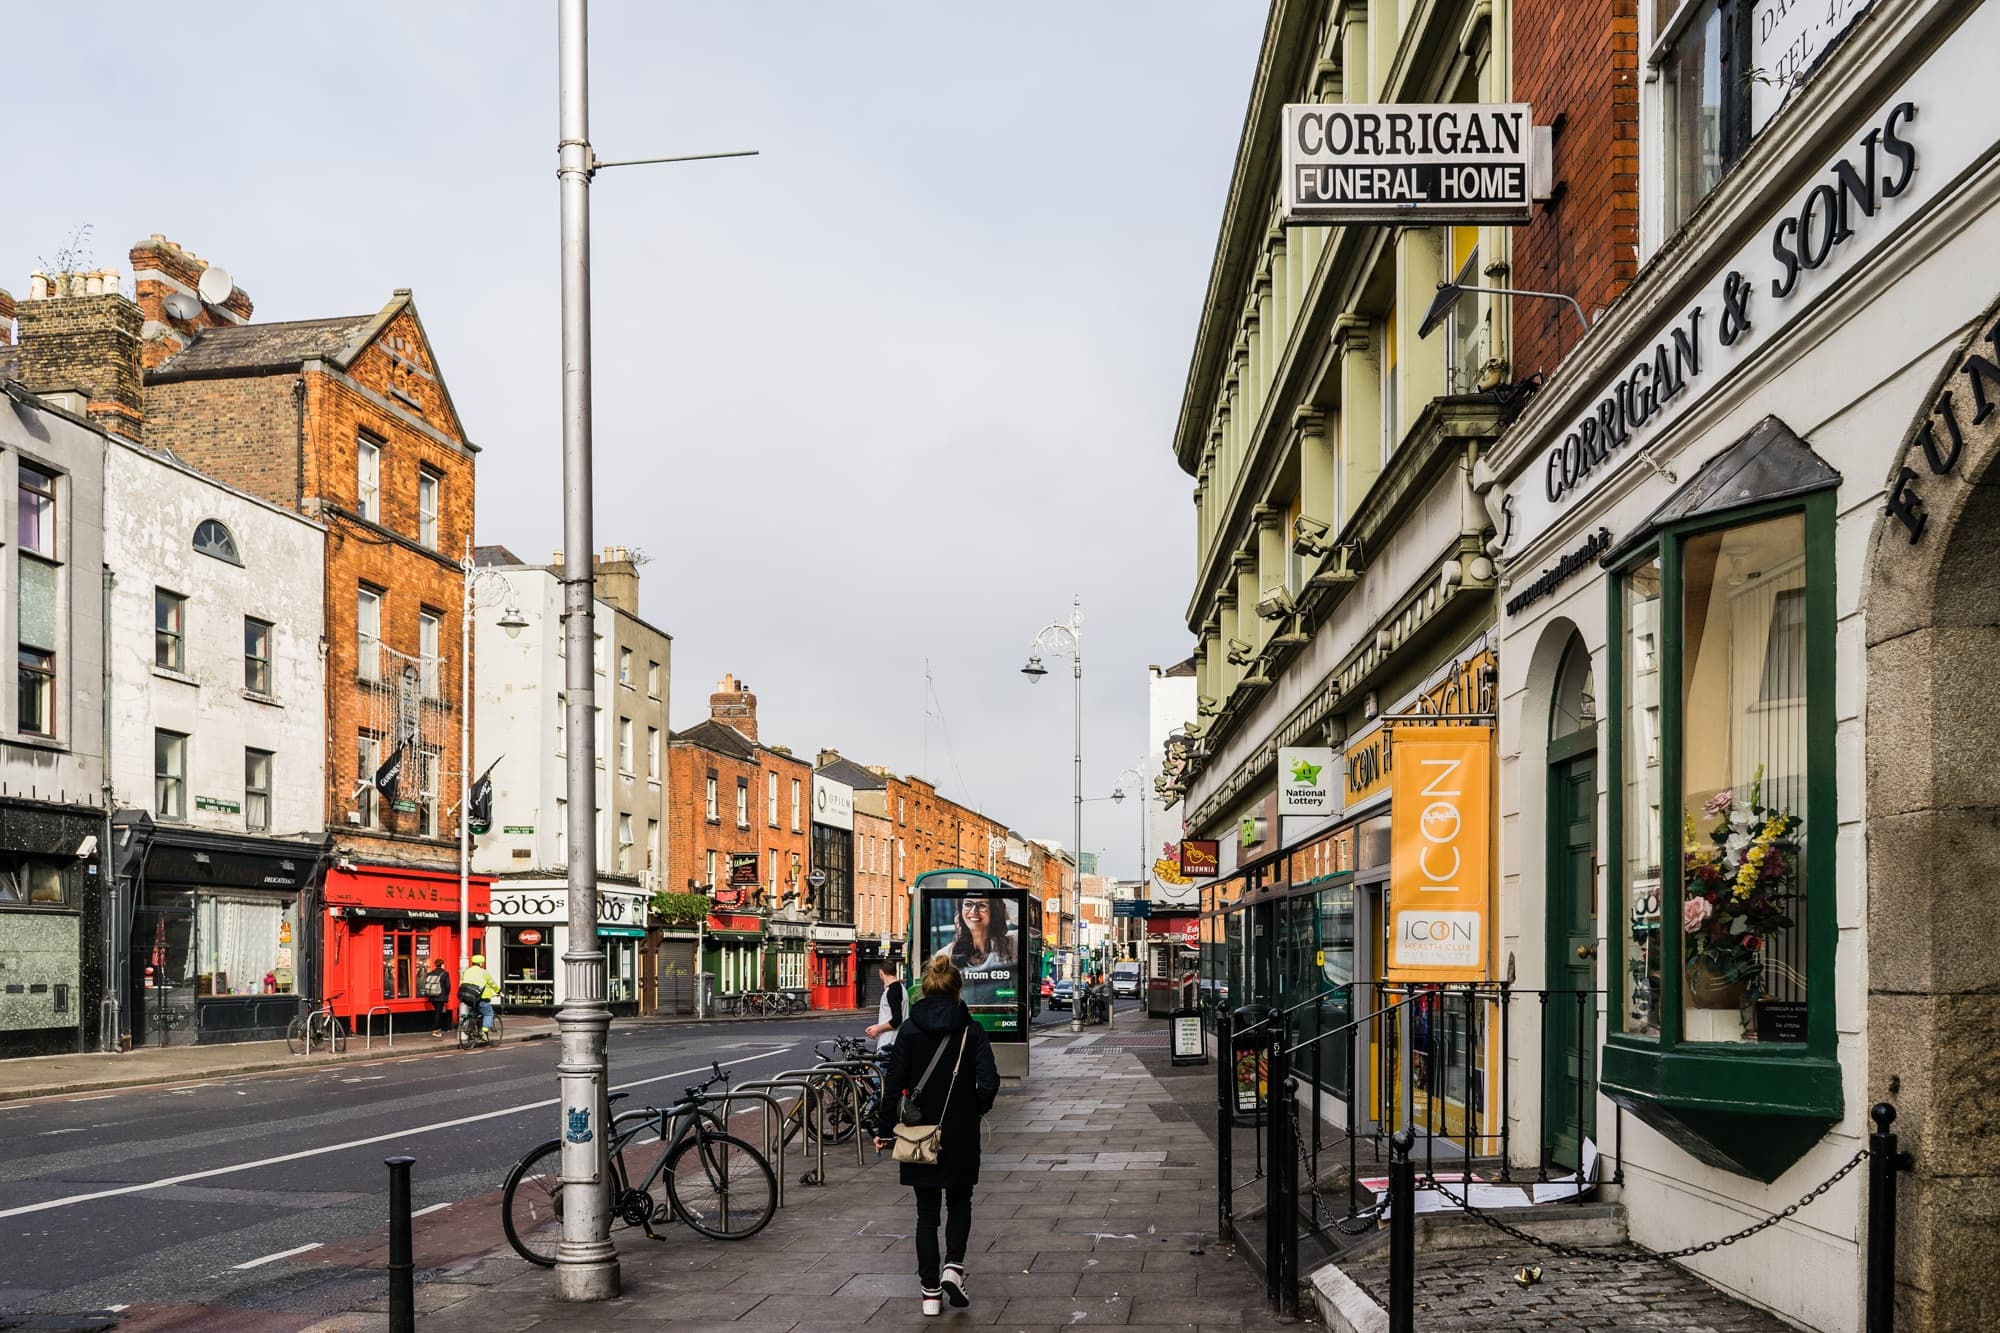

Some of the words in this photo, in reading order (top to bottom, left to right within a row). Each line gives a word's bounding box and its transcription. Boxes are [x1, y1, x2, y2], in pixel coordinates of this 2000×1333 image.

[1760, 0, 1797, 47] DA
[1297, 112, 1523, 156] CORRIGAN
[1300, 167, 1428, 199] FUNERAL
[1440, 167, 1521, 199] HOME
[1545, 306, 1702, 503] CORRIGAN
[1719, 271, 1752, 346] &
[1772, 102, 1915, 298] SONS
[1350, 741, 1380, 793] ICON
[1286, 788, 1326, 798] National
[1288, 796, 1323, 807] Lottery
[1419, 759, 1461, 892] ICON
[386, 883, 438, 902] RYAN'S
[1405, 920, 1471, 941] ICON
[1404, 943, 1441, 951] HEALTH
[1446, 943, 1471, 951] CLUB
[965, 970, 988, 979] from
[990, 970, 1010, 979] €89
